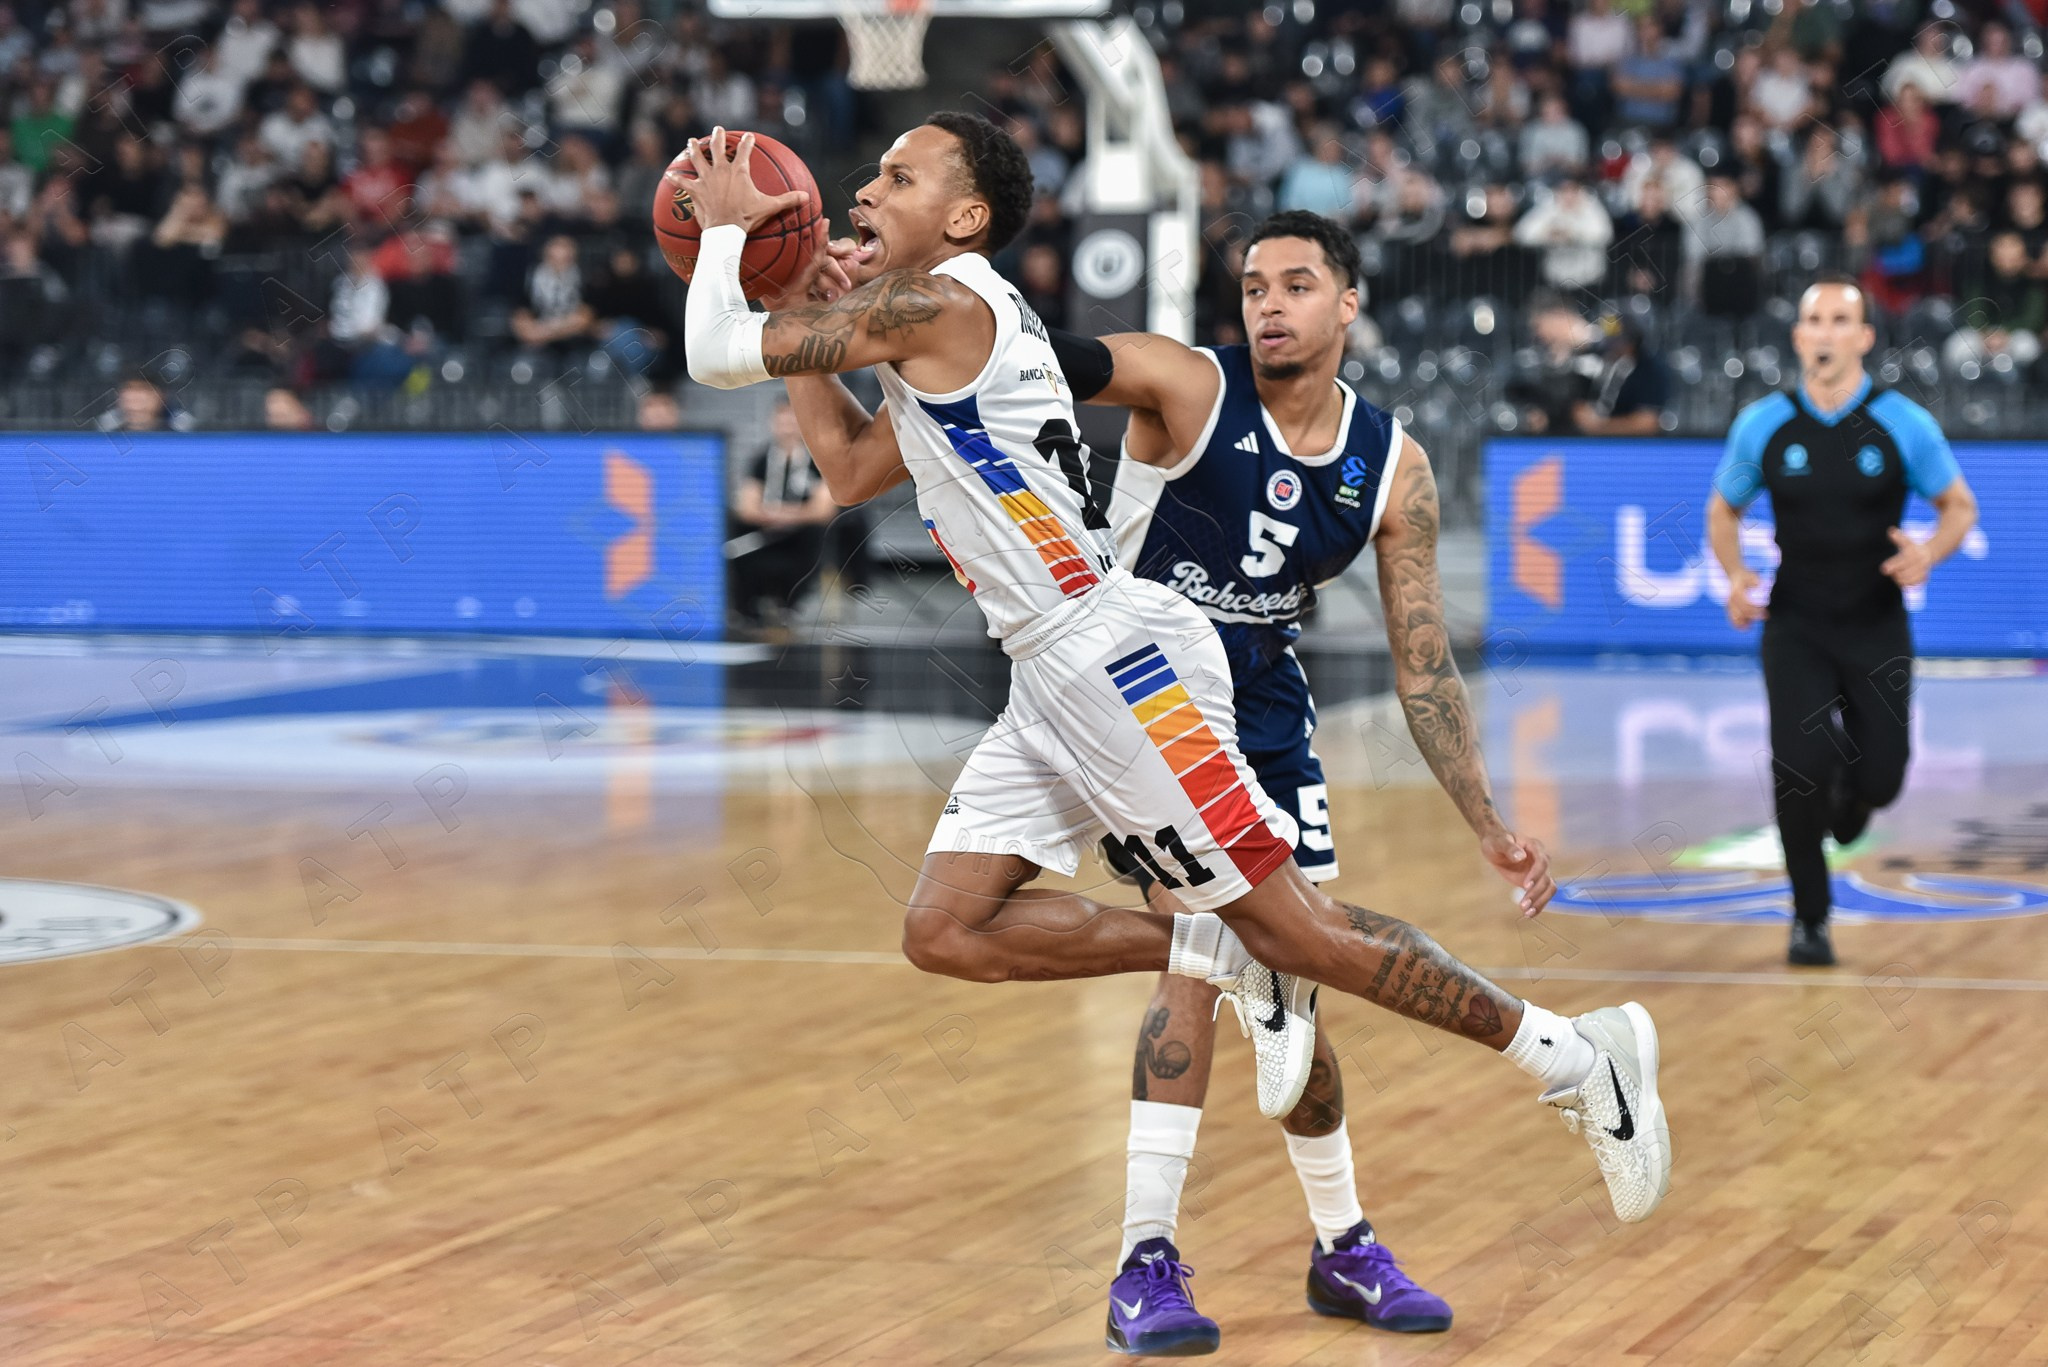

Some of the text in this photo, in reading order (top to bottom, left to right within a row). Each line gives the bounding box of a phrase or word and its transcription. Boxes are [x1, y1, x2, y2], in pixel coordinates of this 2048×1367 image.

[1020, 368, 1046, 382] BANCA
[1240, 510, 1300, 578] 5
[943, 806, 961, 816] EAK
[1298, 784, 1334, 852] 5
[1123, 824, 1217, 890] 11
